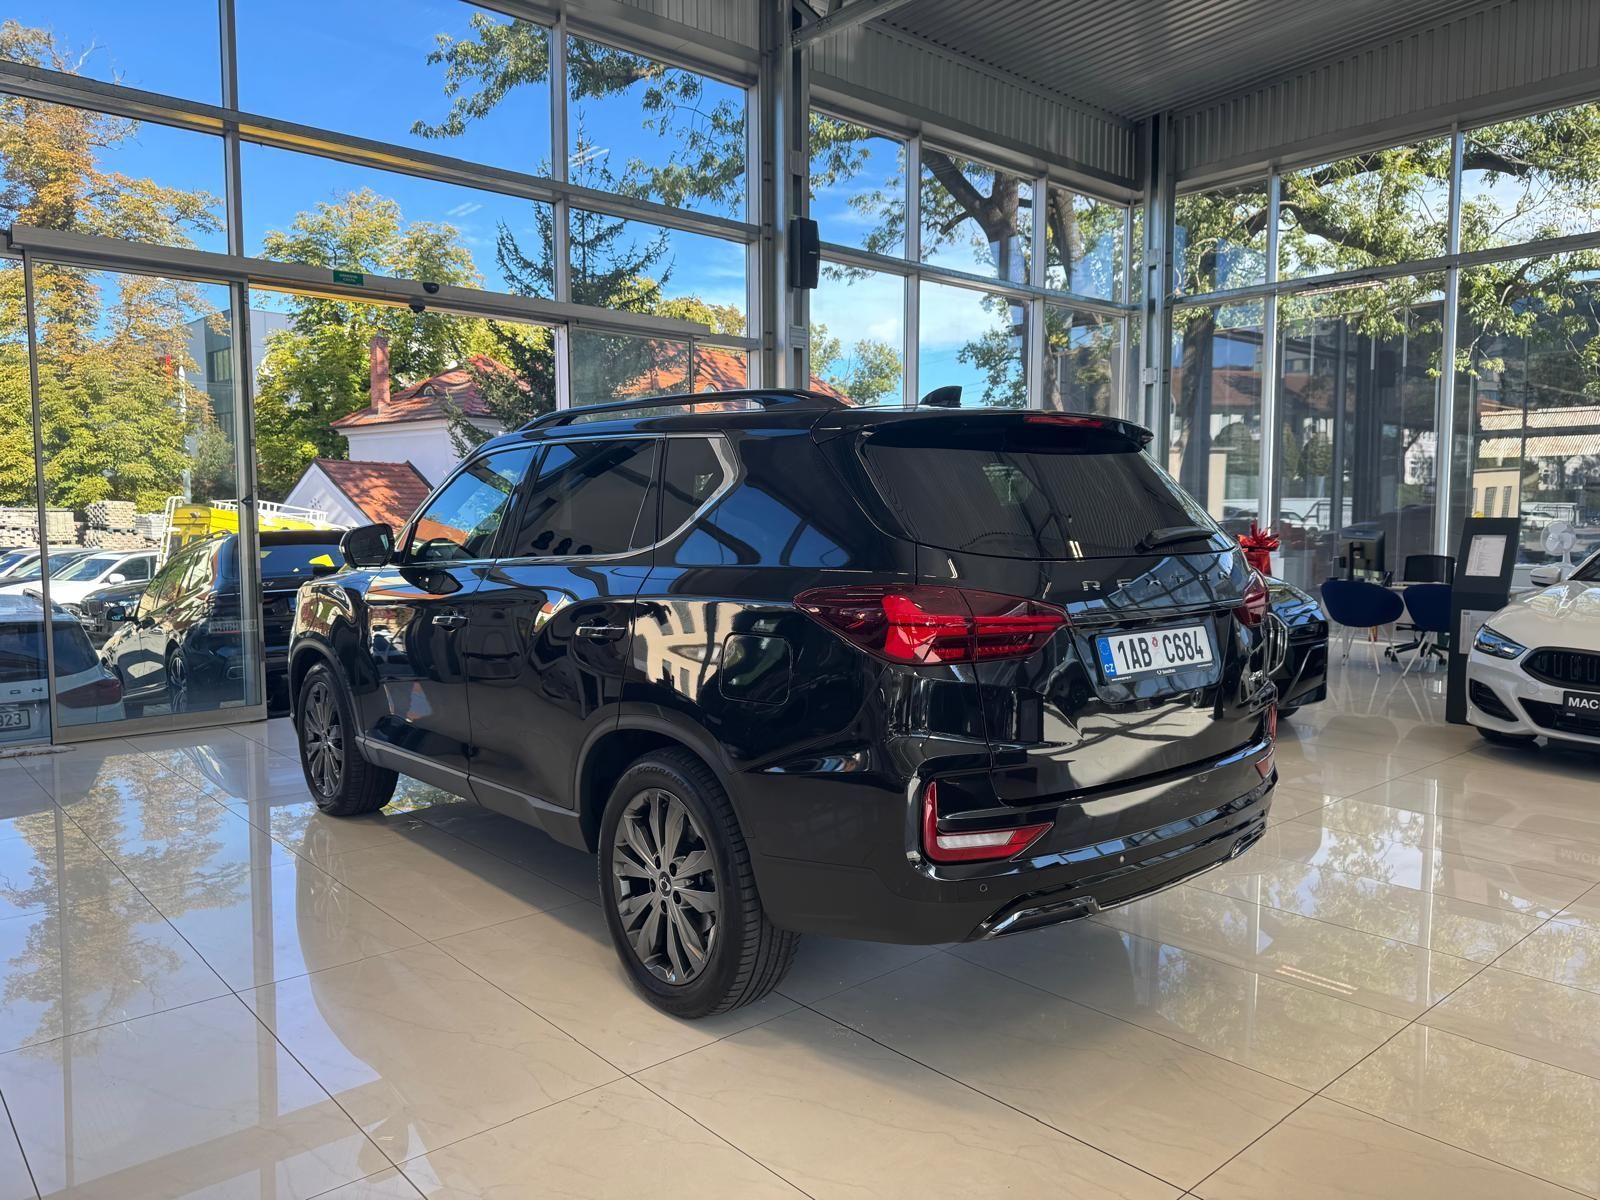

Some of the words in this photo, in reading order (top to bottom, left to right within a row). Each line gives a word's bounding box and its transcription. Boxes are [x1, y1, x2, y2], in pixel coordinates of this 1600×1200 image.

[1117, 637, 1153, 671] 1AB
[1162, 630, 1204, 664] C684
[1104, 663, 1115, 673] CZ
[1568, 696, 1600, 710] MAC
